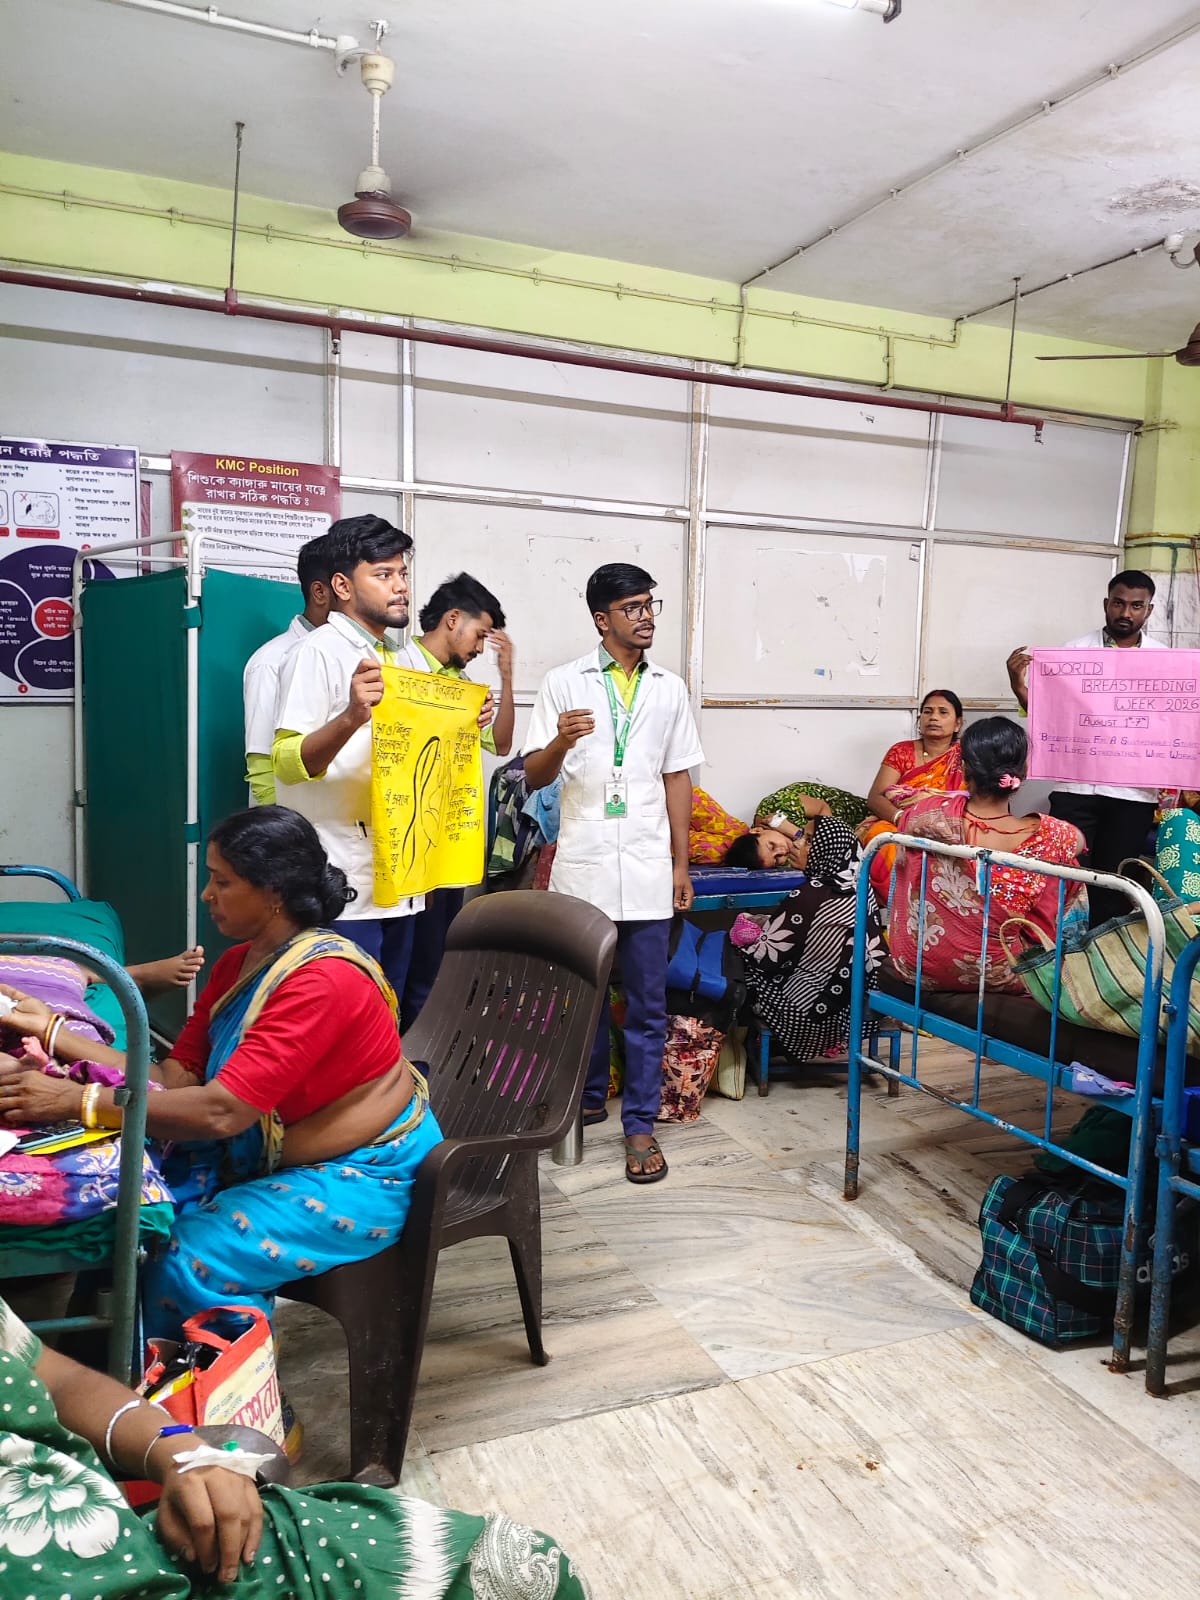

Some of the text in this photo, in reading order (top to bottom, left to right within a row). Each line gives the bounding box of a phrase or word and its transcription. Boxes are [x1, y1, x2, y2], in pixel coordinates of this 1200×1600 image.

[59, 449, 101, 462] পদ্ধতি
[215, 459, 299, 476] KMC Position
[187, 471, 226, 486] শিশুকে
[271, 481, 302, 492] মায়ের
[306, 484, 326, 497] যত্নে
[205, 488, 236, 500] রাখার
[240, 490, 268, 502] সঠিক
[271, 493, 301, 506] পদ্ধতি
[1043, 663, 1102, 675] WORLD
[1083, 680, 1194, 692] BREASTFEEDING
[1115, 698, 1199, 711] WEEK 2026
[1083, 717, 1117, 727] AUGUST
[1110, 736, 1117, 745] A
